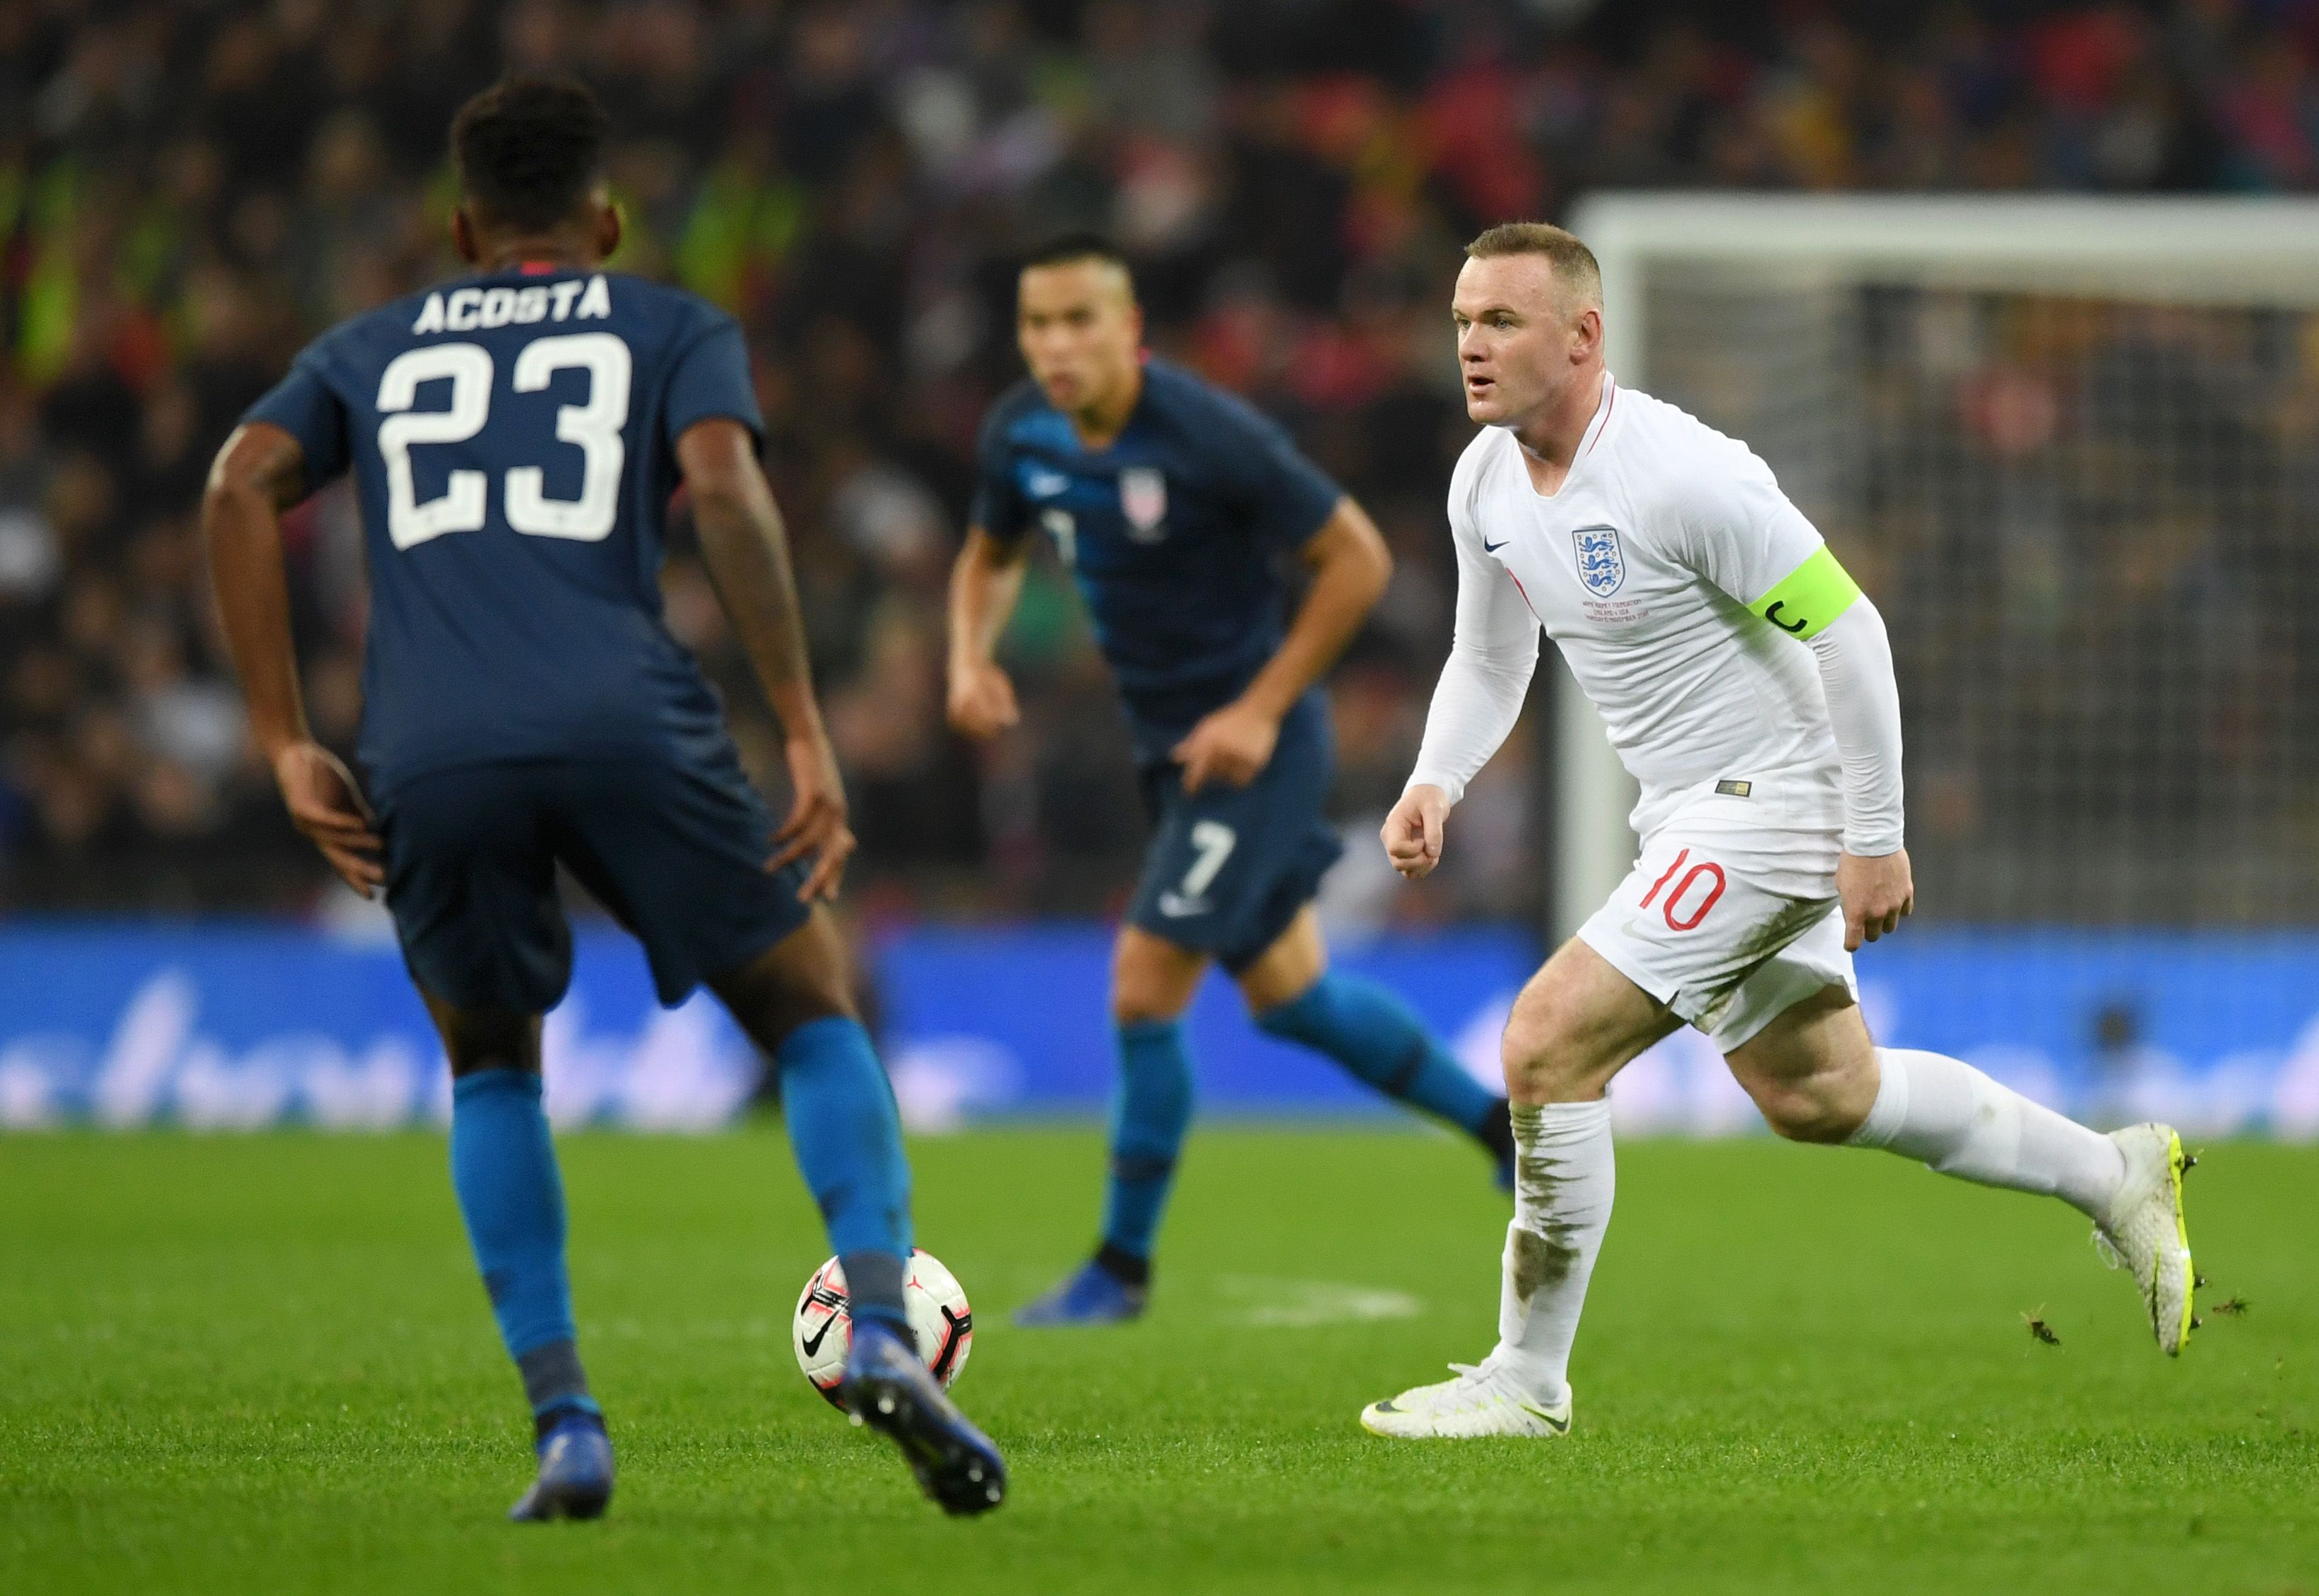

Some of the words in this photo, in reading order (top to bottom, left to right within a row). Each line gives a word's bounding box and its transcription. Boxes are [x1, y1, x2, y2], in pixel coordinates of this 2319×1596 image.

[412, 274, 612, 335] ACOSTA
[376, 332, 633, 551] 23
[1765, 600, 1808, 633] C
[1183, 819, 1237, 898] 7
[1639, 848, 1726, 931] 10
